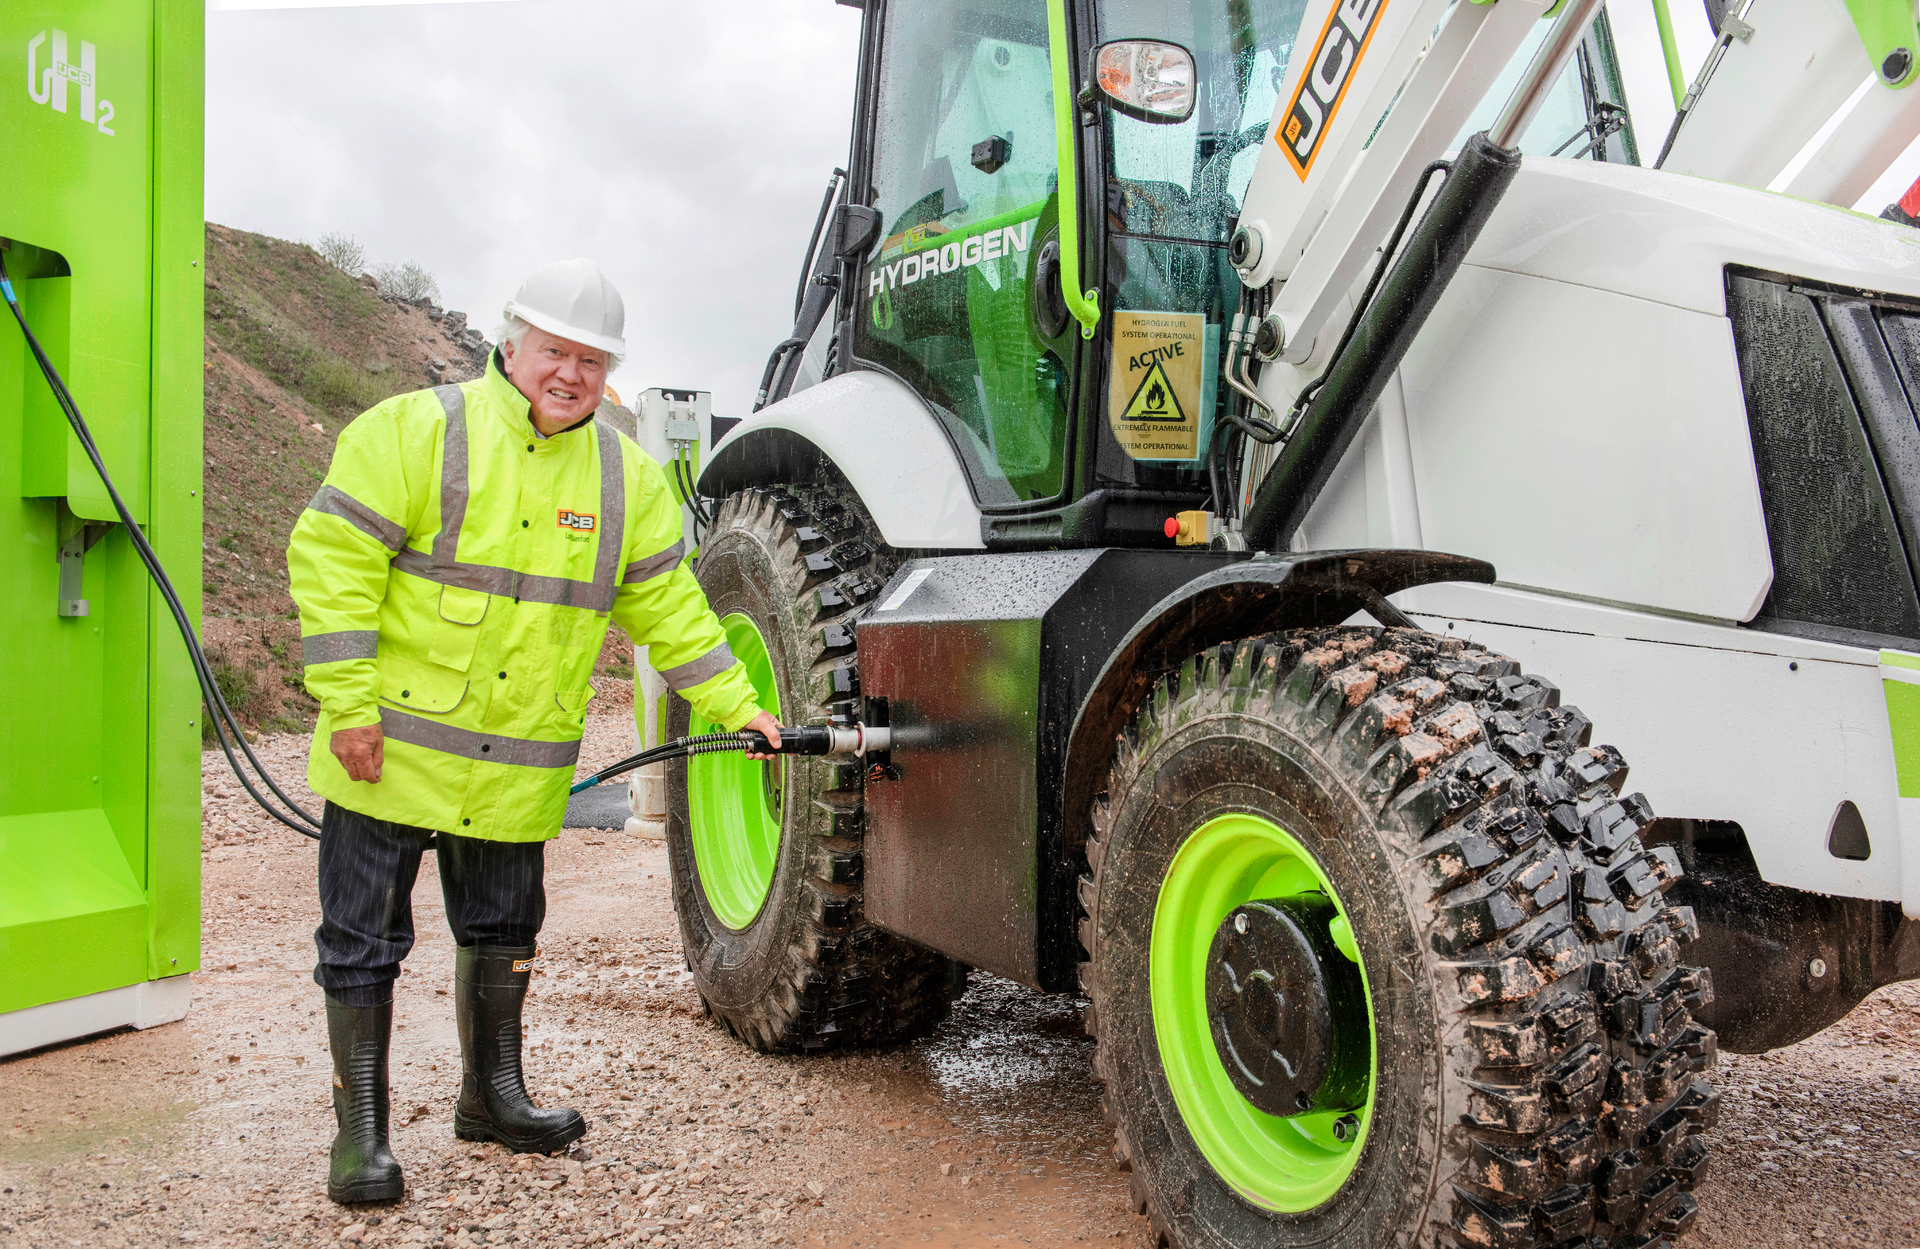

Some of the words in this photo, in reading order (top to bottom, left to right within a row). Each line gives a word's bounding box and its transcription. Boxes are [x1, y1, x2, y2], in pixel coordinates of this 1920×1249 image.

[58, 62, 90, 87] JCB
[869, 222, 1028, 298] HYDROGEN
[1132, 319, 1170, 328] HYDROGEN
[1171, 320, 1187, 328] FUEL
[1122, 330, 1148, 338] SYSTEM
[1150, 331, 1196, 340] OPERATIONAL
[1129, 341, 1185, 372] ACTIVE
[1152, 424, 1193, 432] FLAMMABLE
[1143, 442, 1189, 450] OPERATIONAL
[560, 513, 594, 528] JCB
